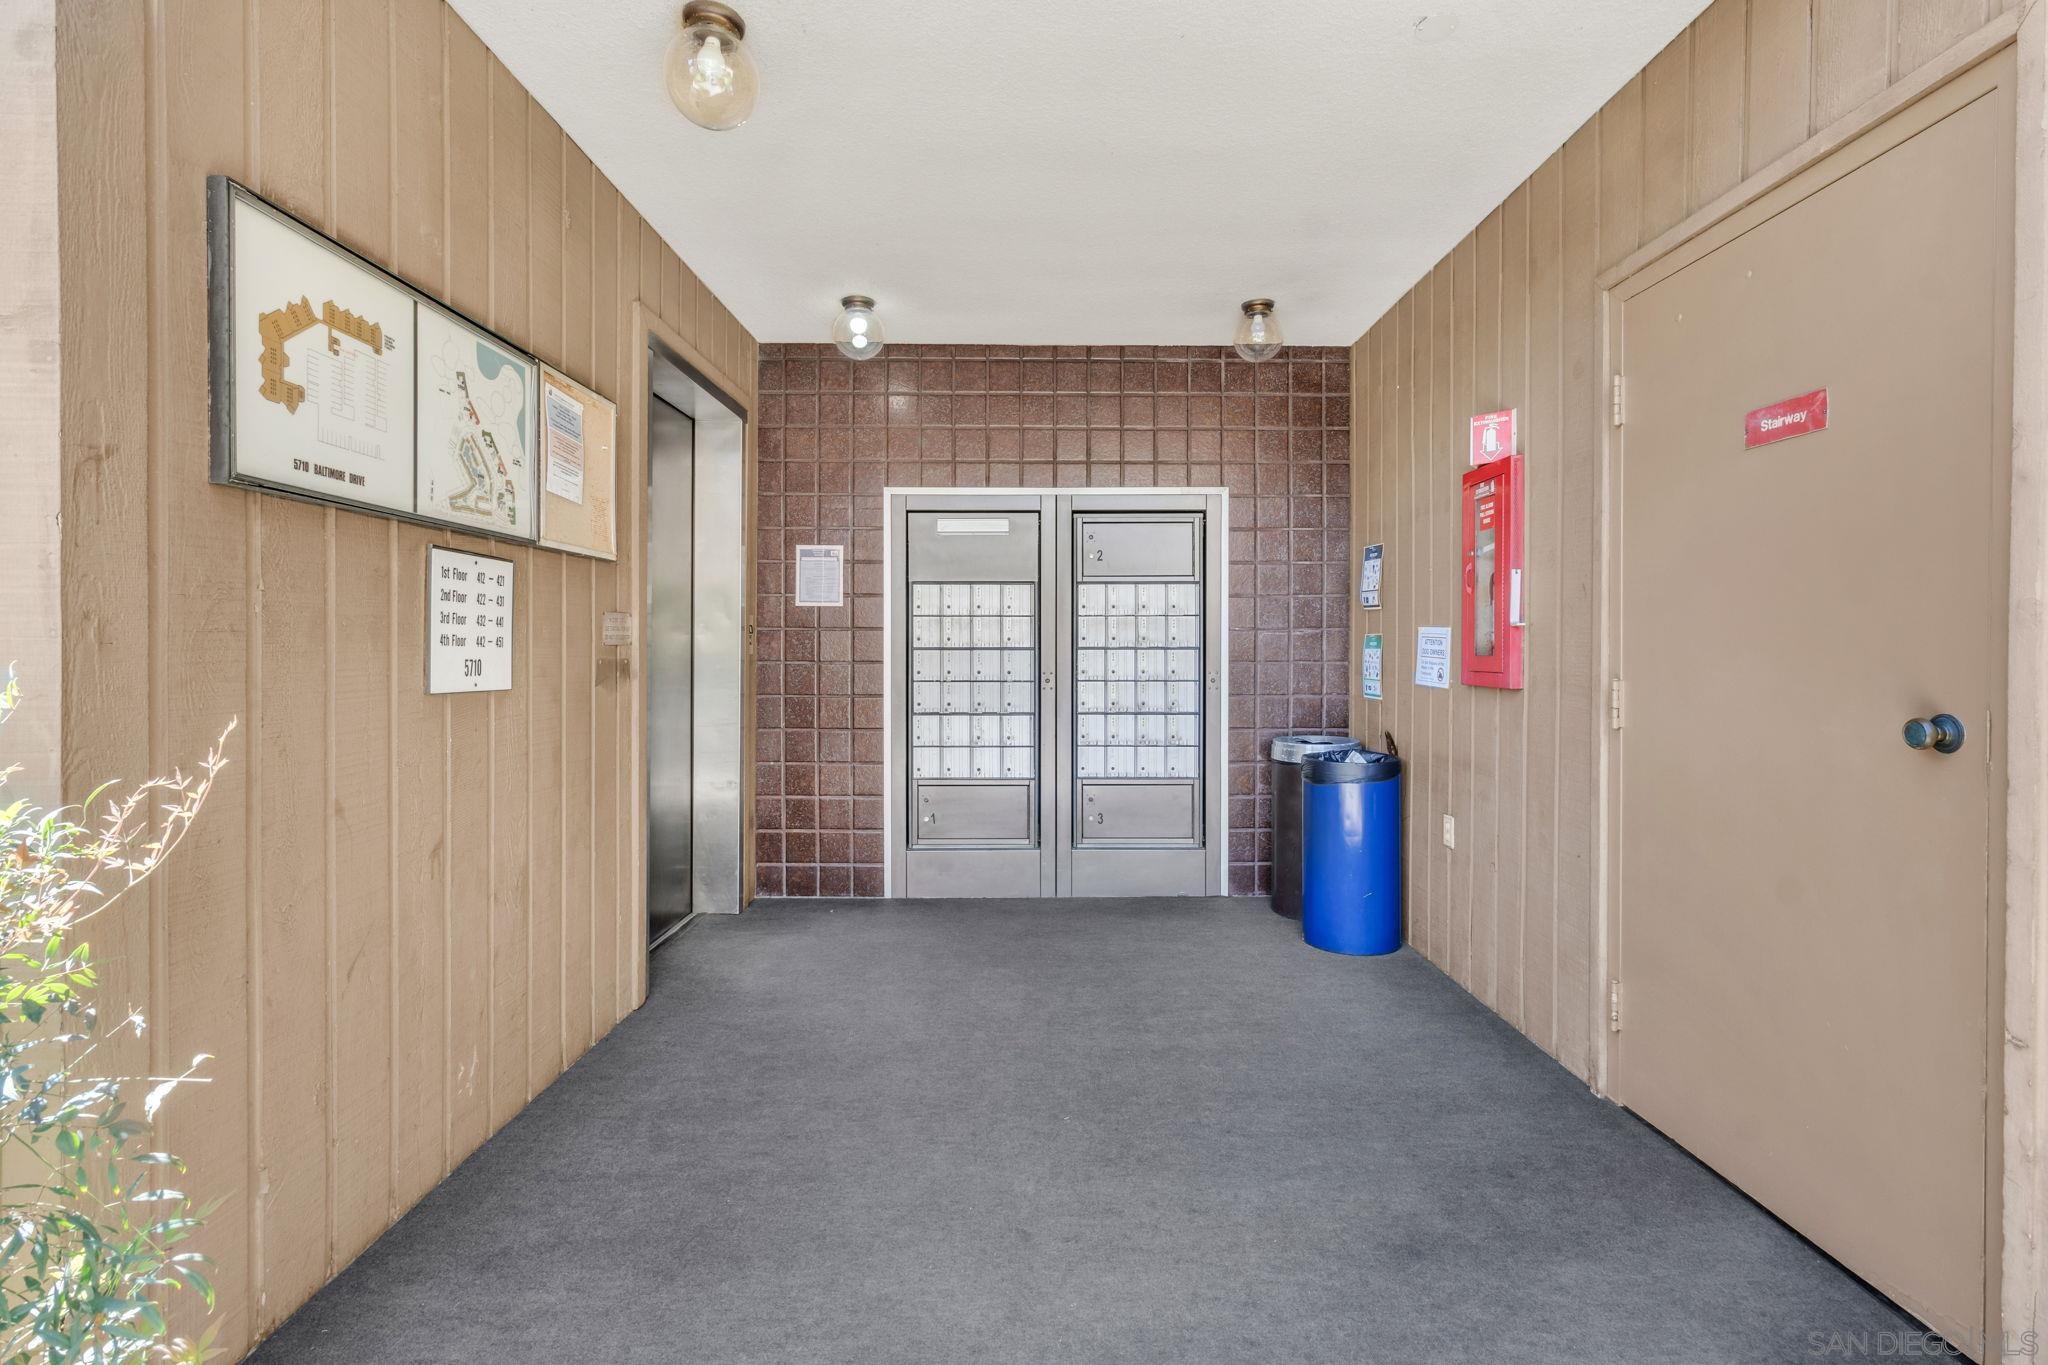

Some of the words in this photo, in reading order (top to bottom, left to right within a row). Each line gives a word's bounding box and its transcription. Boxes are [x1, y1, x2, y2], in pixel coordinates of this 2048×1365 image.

[1760, 410, 1807, 432] Stairway
[293, 459, 309, 472] 5710
[314, 464, 346, 482] BALTIMORE
[349, 473, 365, 486] DRIVE
[1097, 549, 1103, 561] 2
[441, 566, 450, 579] 1st
[453, 568, 468, 582] Floor
[477, 572, 486, 584] 412
[496, 575, 505, 587] 421
[440, 588, 451, 602] 2nd
[452, 590, 467, 603] Floor
[476, 593, 486, 605] 422
[496, 596, 504, 607] 431
[440, 611, 450, 624] 3rd
[452, 613, 467, 625] Floor
[476, 615, 486, 627] 432
[495, 617, 504, 628] 441
[440, 634, 450, 646] 4th
[451, 635, 466, 647] Floor
[476, 636, 486, 648] 442
[495, 637, 504, 648] 451
[1424, 638, 1443, 646] ATTENTION
[465, 659, 482, 677] 5710
[930, 812, 936, 825] 1
[1097, 812, 1104, 825] 3
